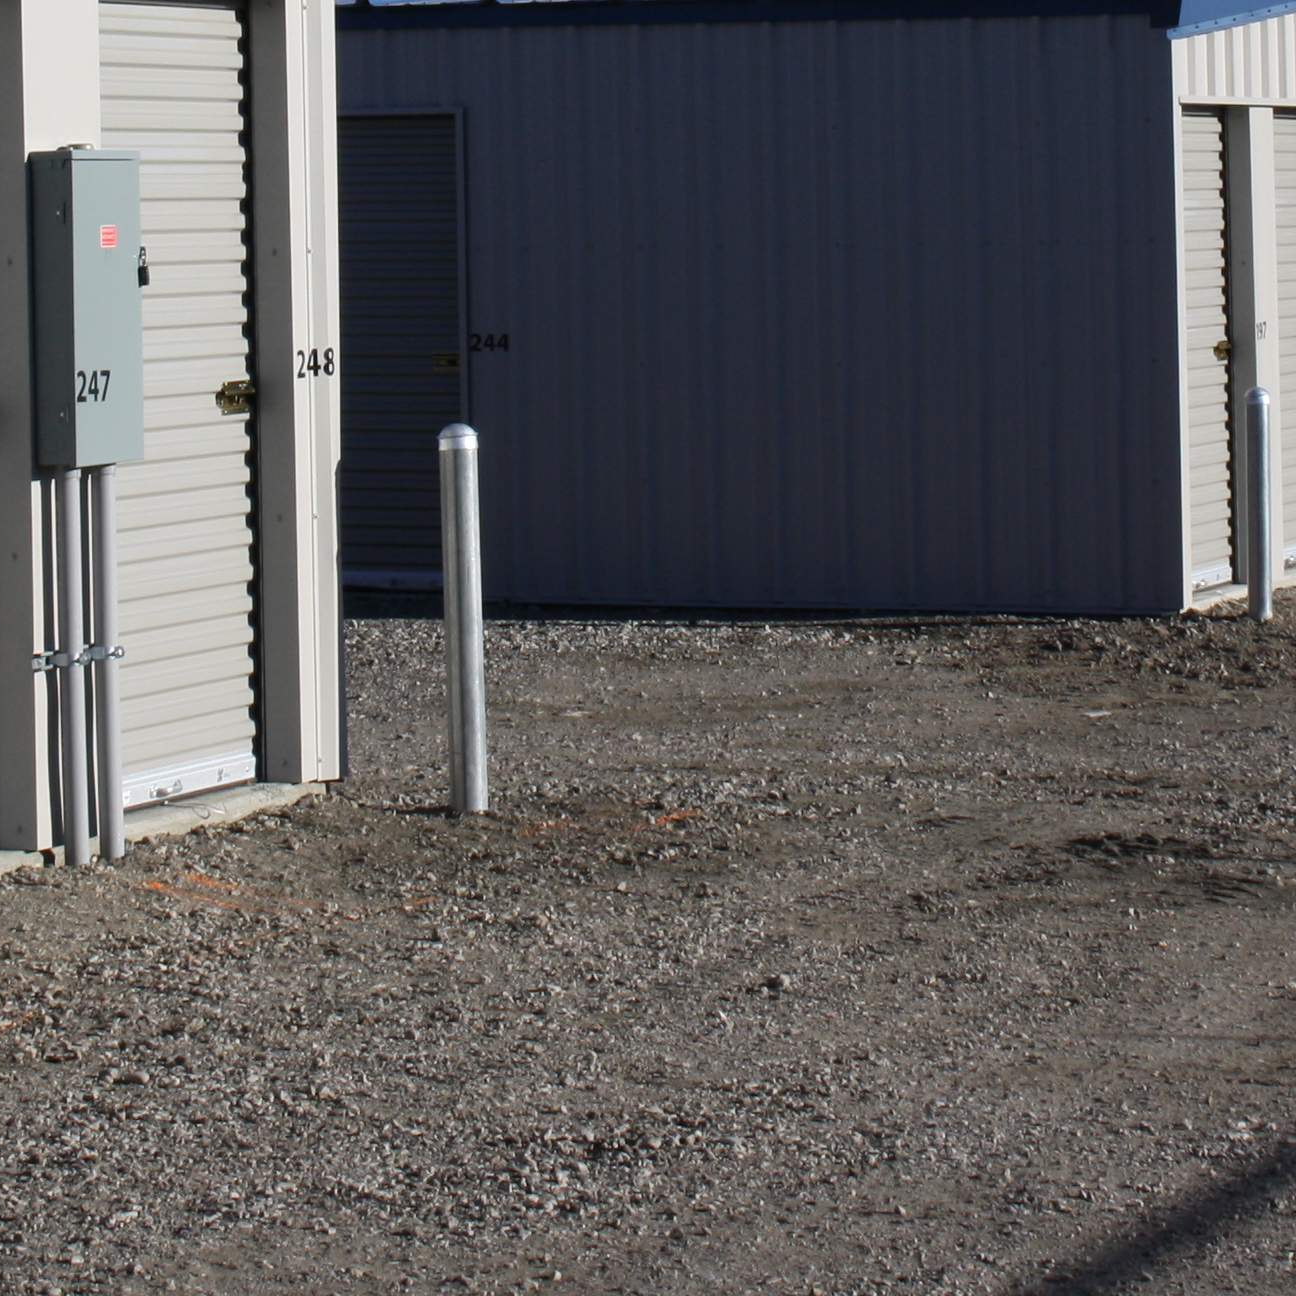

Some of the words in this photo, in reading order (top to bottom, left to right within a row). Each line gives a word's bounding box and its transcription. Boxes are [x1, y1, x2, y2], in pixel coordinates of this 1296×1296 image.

[469, 333, 510, 352] 244
[296, 347, 335, 379] 248
[76, 370, 111, 402] 247
